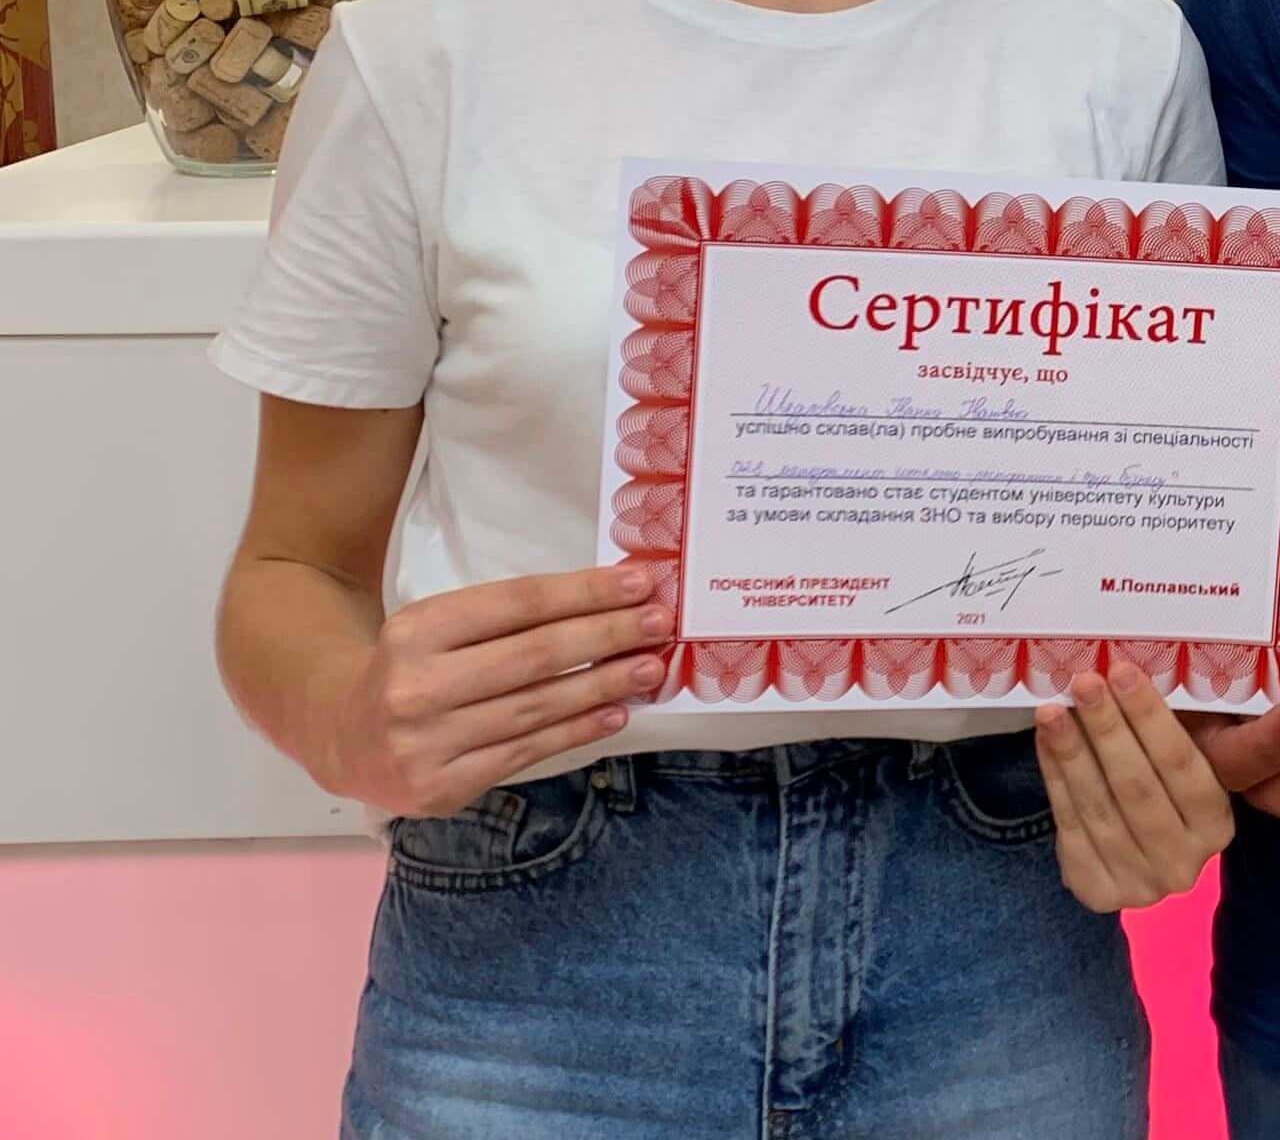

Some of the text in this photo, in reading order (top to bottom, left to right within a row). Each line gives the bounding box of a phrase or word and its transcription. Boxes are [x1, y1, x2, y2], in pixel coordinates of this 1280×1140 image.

[809, 275, 1215, 356] Сертифікат
[917, 362, 1068, 384] засвідчує, що
[735, 419, 1254, 450] успішно склав(ла) пробне випробування зі спеціальності
[736, 485, 1225, 511] та гарантовано стає студентом університету культури
[726, 508, 1236, 535] за умови складання ЗНО та вибору першого пріоритету
[709, 575, 891, 591] ПОЧЕСНИЙ ПРЕЗИДЕНТ
[1099, 577, 1241, 597] М.Поплавський
[742, 594, 857, 608] УНІВЕРСИТЕТУ
[957, 612, 987, 625] 2021
